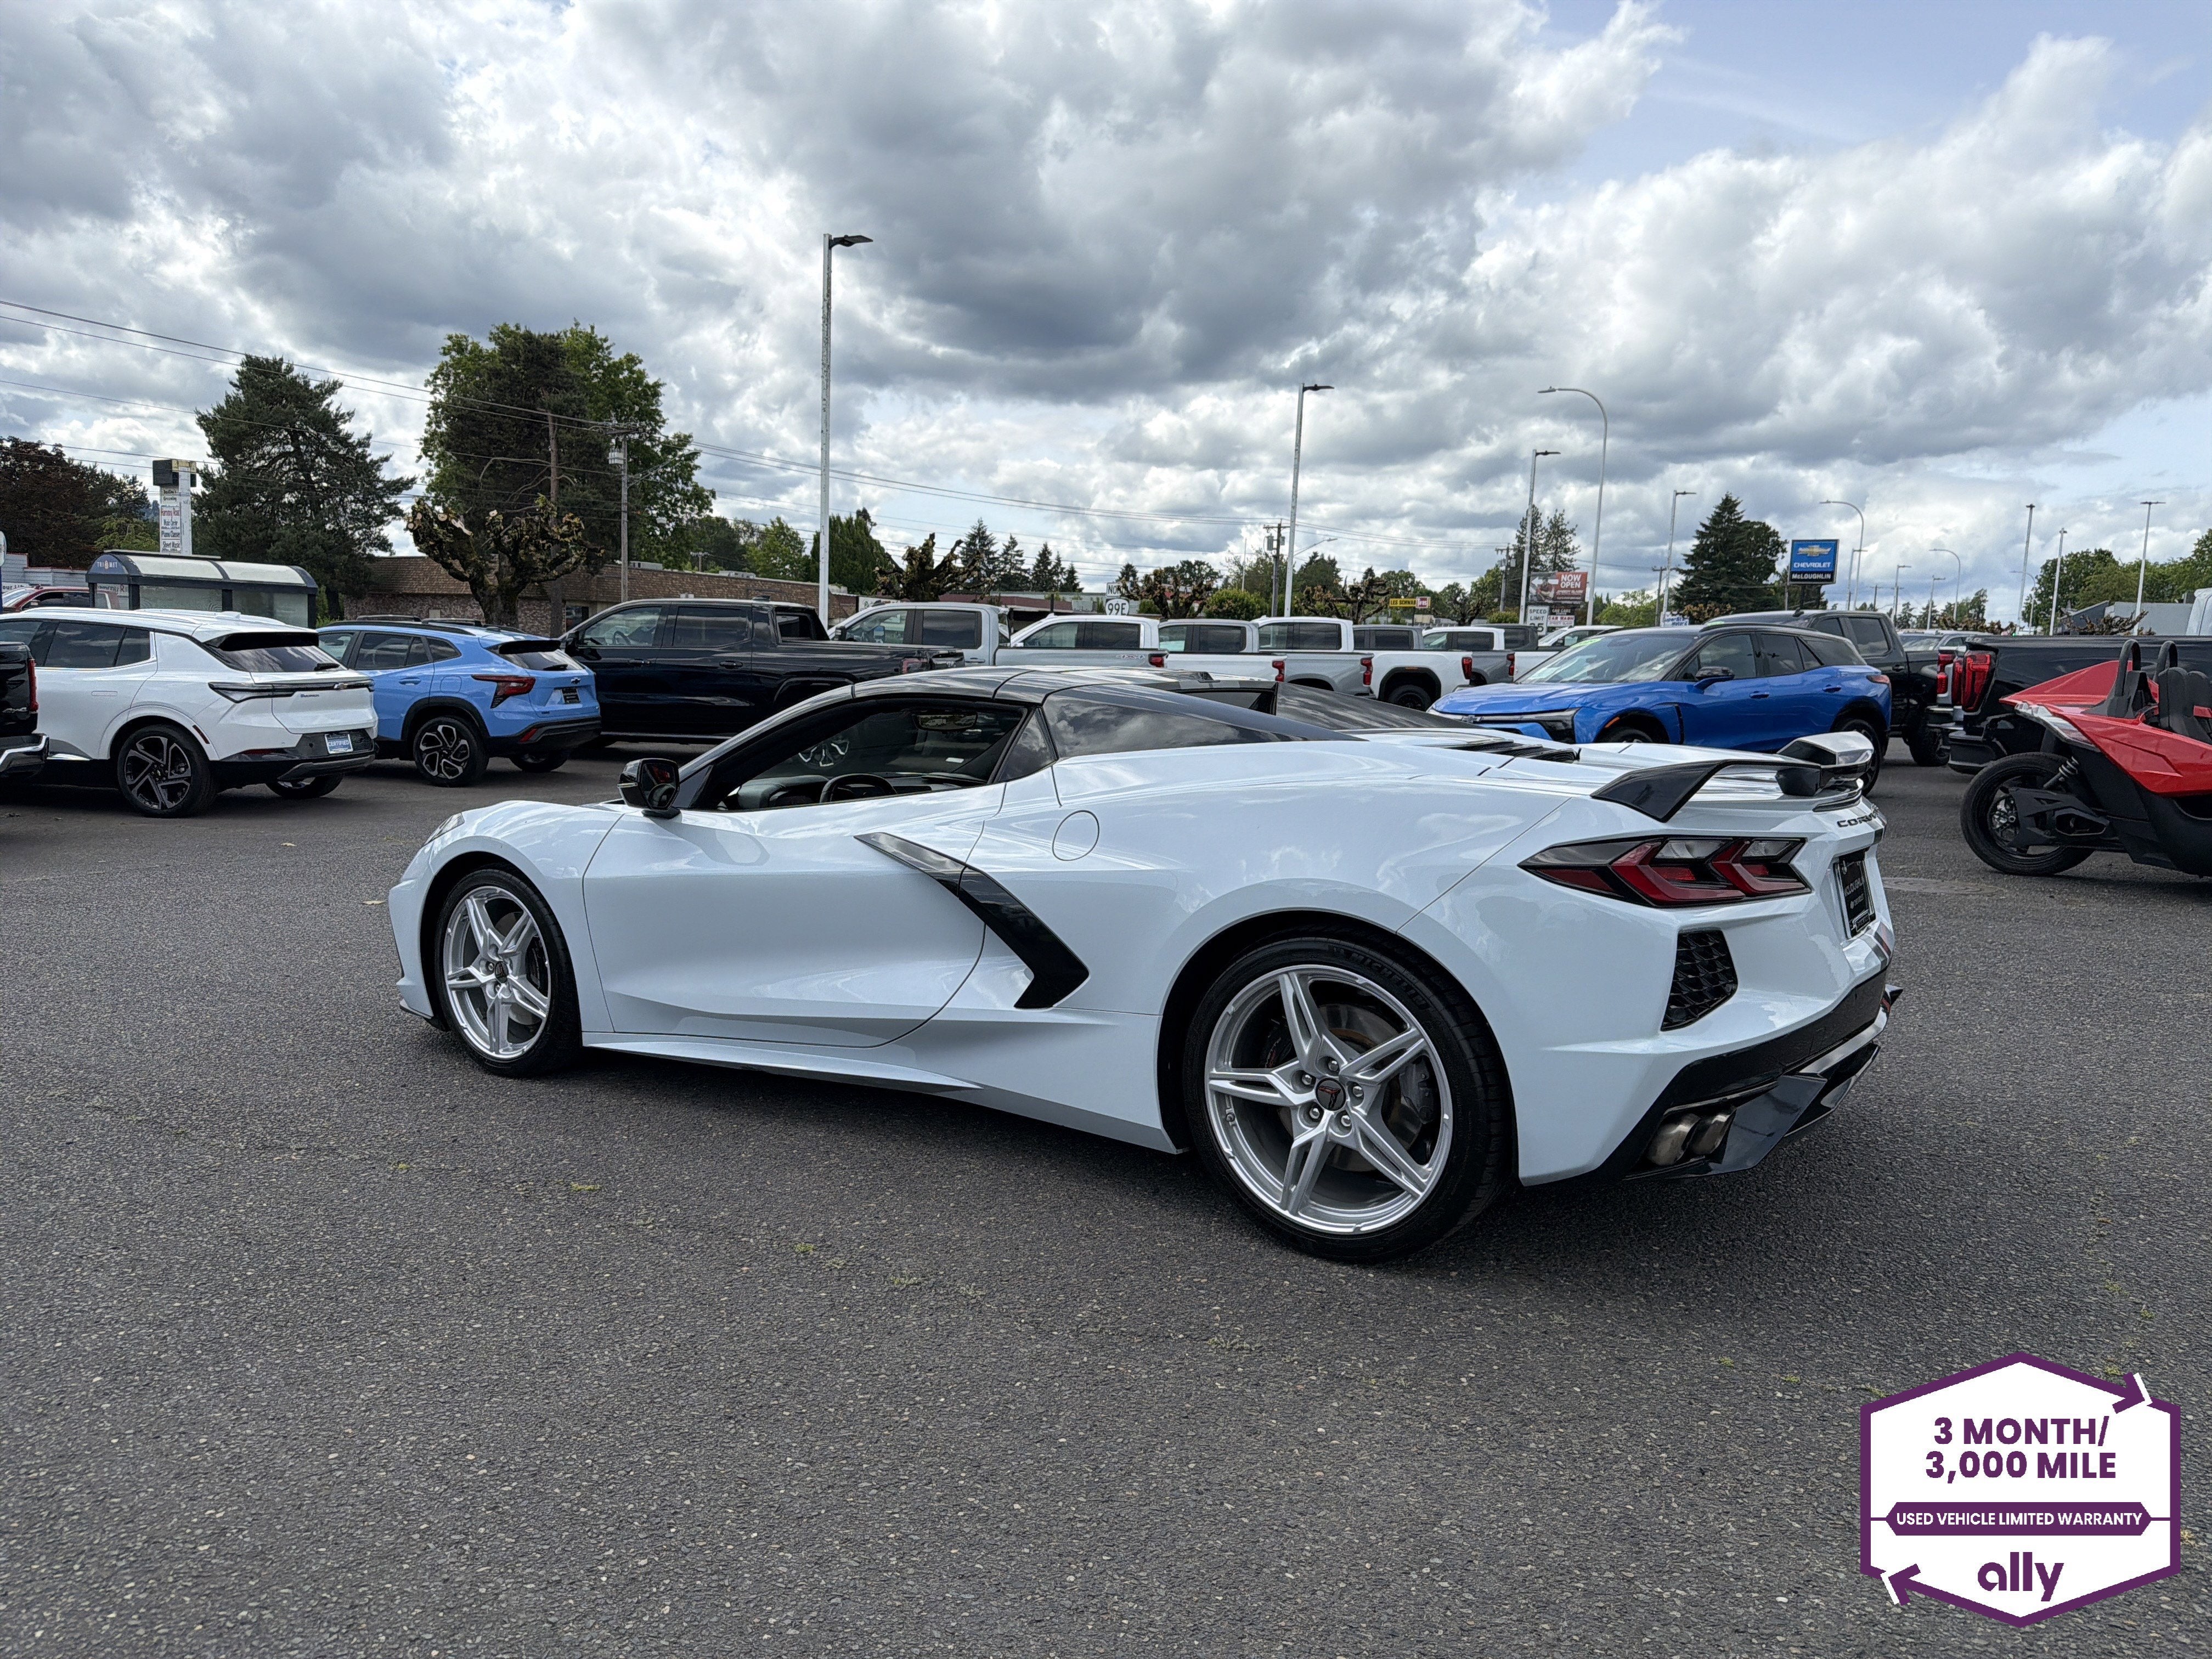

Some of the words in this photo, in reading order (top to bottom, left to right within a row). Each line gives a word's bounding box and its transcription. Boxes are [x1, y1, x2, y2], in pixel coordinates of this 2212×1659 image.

[1561, 574, 1581, 582] NOW
[1108, 602, 1126, 616] 99E
[1350, 952, 1429, 1011] MICHELIN
